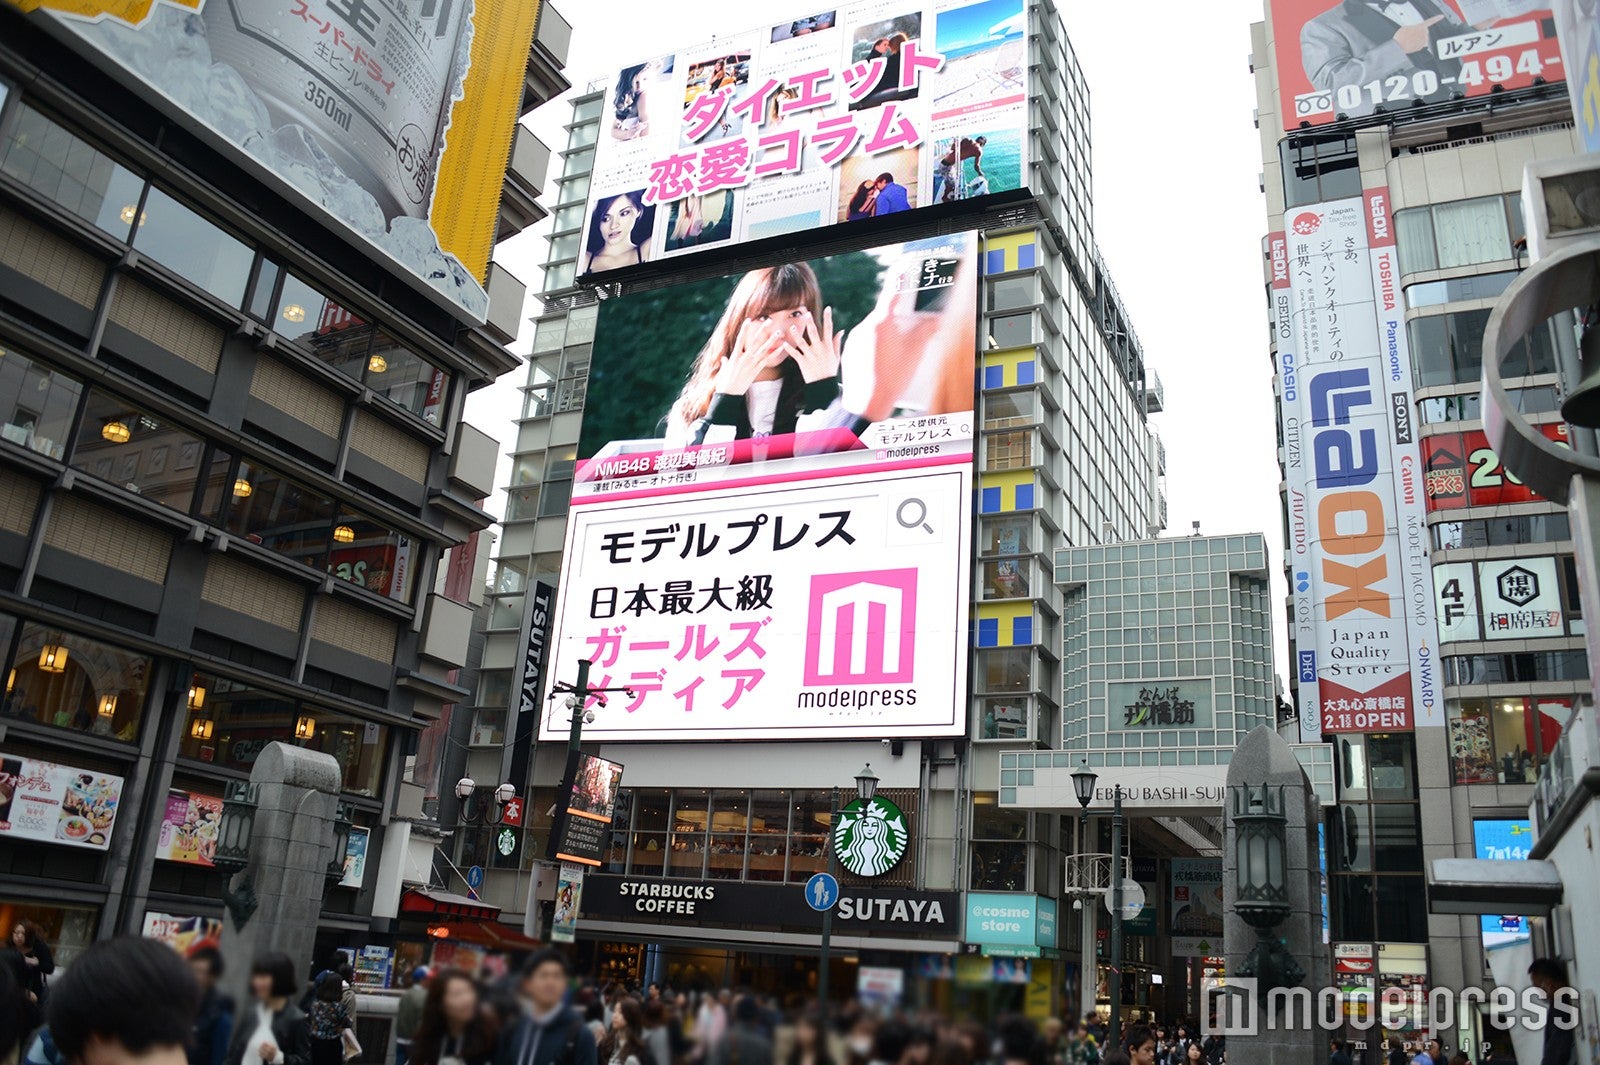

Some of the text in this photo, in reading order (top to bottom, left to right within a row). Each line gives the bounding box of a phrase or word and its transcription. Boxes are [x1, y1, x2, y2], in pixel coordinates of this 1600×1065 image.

[1444, 33, 1502, 56] ルアン
[313, 41, 362, 87] 生ビール
[683, 42, 942, 139] ダイエット
[304, 81, 352, 132] 350ml
[650, 105, 918, 201] 恋愛コラム
[1297, 243, 1312, 284] 世界へ。
[1344, 236, 1358, 264] さあ、
[1378, 253, 1395, 311] TOSHIBA
[1320, 239, 1344, 361] ジャパンクオリティの
[1278, 296, 1291, 339] SEIKO
[1386, 321, 1401, 381] Panasonic
[1282, 353, 1296, 402] CASIO
[1394, 395, 1410, 441] SONY
[886, 445, 940, 459] modelpress
[1287, 417, 1301, 468] CITIZEN
[595, 447, 726, 477] NMB48 渡辺美優紀
[1400, 456, 1415, 505] Canon
[1427, 475, 1464, 496] うちくる
[1291, 486, 1307, 555] SHISEIDO
[600, 510, 856, 564] モデルプレス
[1407, 515, 1426, 626] MODE ET JACOMO
[590, 574, 774, 619] 日本最大級
[1506, 575, 1530, 597] 相席
[1489, 610, 1551, 631] 相席屋
[584, 615, 773, 667] ガールズ
[1331, 628, 1390, 644] Japan
[520, 595, 550, 713] TSUTAYA
[1302, 653, 1314, 680] DHC
[1331, 646, 1390, 661] Quality
[1331, 663, 1392, 676] Store
[1418, 646, 1434, 709] ONWARD
[798, 688, 917, 710] modelpress
[1139, 686, 1179, 702] なんば
[1324, 696, 1405, 712] 大丸心斎橋店
[1124, 700, 1195, 726] 戎橋筋
[1355, 712, 1405, 728] OPEN
[1096, 787, 1139, 800] EBSU
[619, 882, 715, 901] STARBUCKS
[635, 899, 695, 915] COFFEE
[837, 896, 945, 924] SUTAYA
[973, 905, 1030, 919] @cosme
[982, 920, 1020, 932] store
